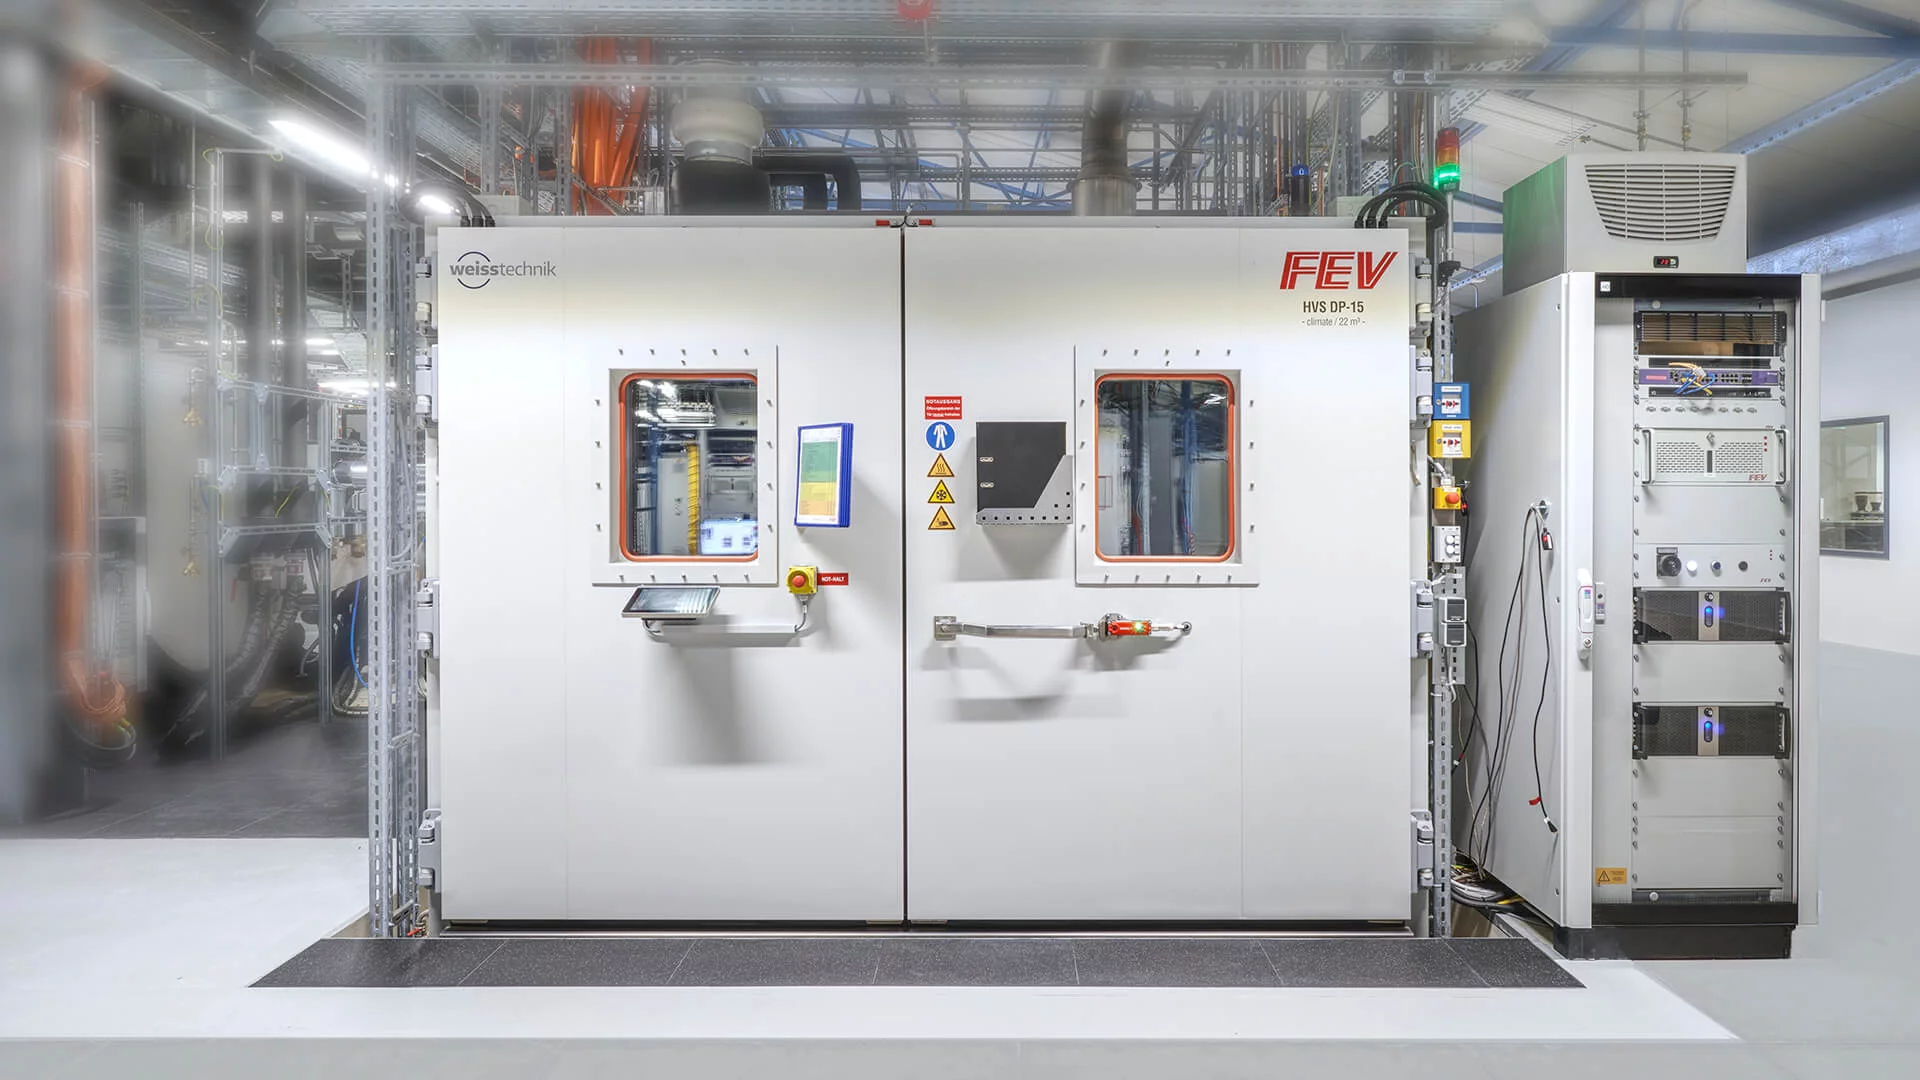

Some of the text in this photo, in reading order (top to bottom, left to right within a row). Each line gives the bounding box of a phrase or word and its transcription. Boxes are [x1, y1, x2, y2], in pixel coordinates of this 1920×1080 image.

[449, 260, 557, 276] weisstechnik
[1279, 251, 1399, 290] FEV
[1303, 301, 1364, 313] HVS DP-15
[1306, 317, 1333, 326] climate
[1338, 317, 1349, 326] 22
